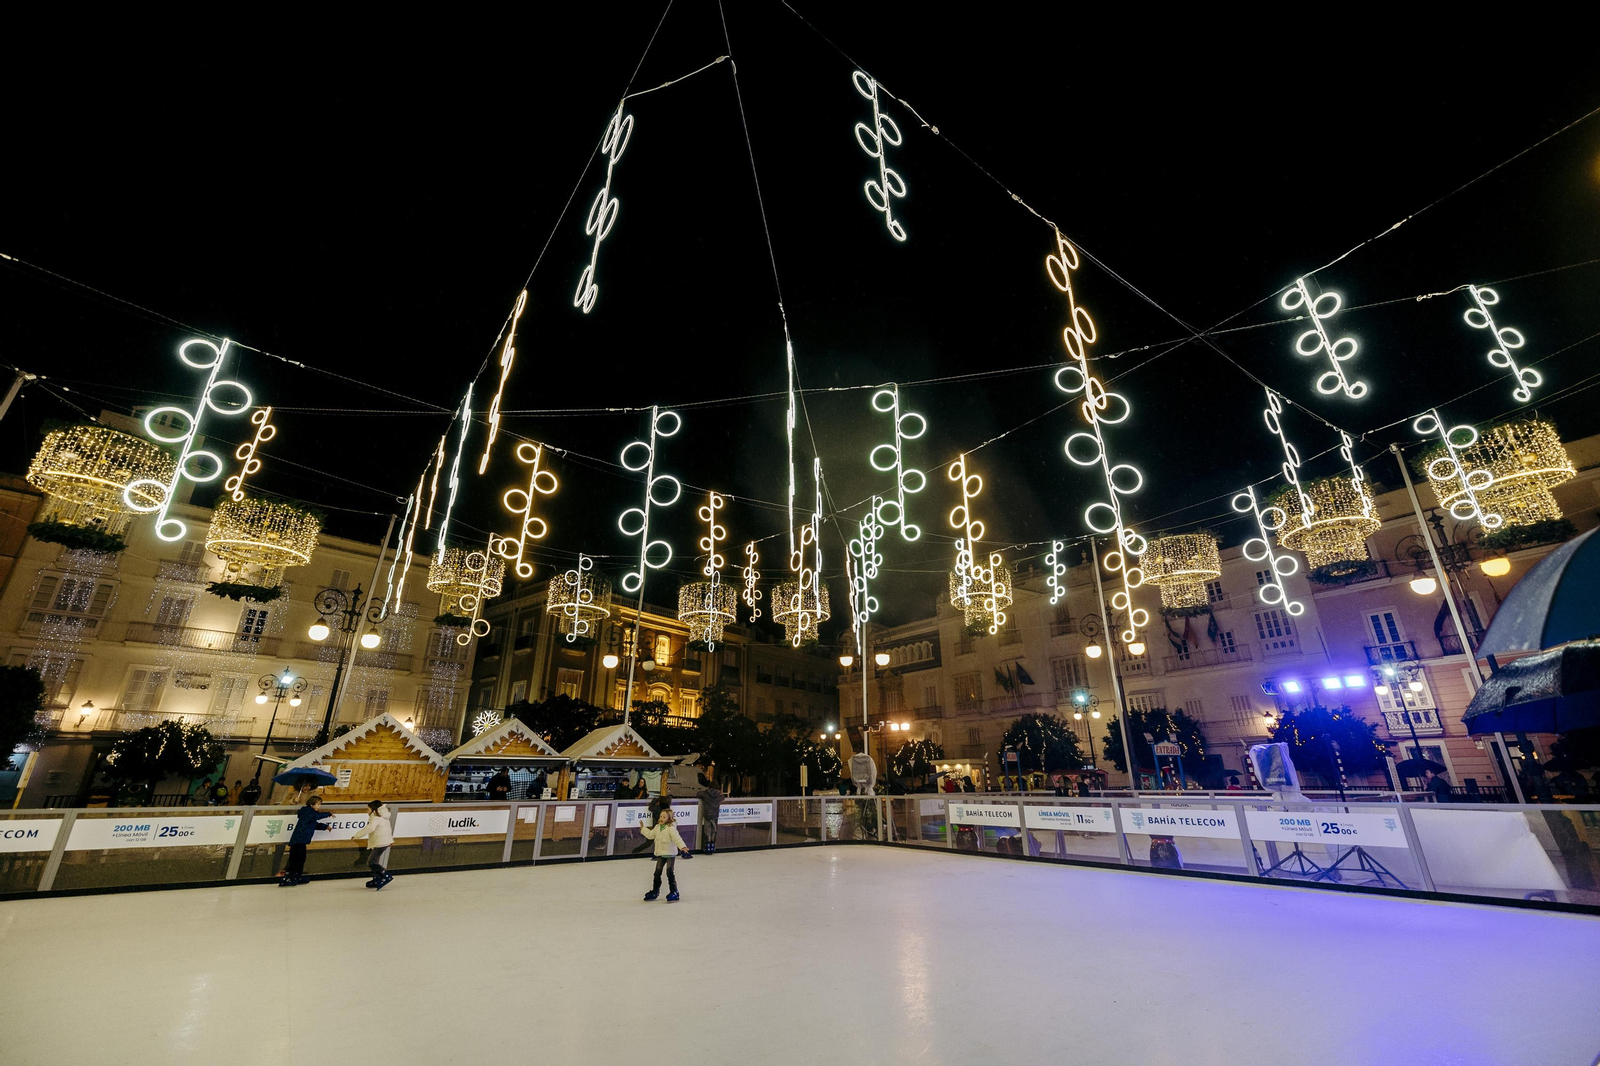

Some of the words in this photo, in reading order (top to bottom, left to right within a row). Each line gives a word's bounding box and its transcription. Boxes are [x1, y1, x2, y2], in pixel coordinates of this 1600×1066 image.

[1156, 746, 1180, 755] ENTRADA
[966, 809, 983, 817] BAHÍA
[984, 810, 1013, 818] TELECOM
[1076, 814, 1084, 824] 11
[1148, 815, 1176, 825] BAHÍA
[1179, 817, 1226, 827] TELECOM
[113, 824, 133, 832] 200
[326, 821, 369, 829] TELECO
[1321, 822, 1340, 834] 25
[158, 826, 179, 838] 25
